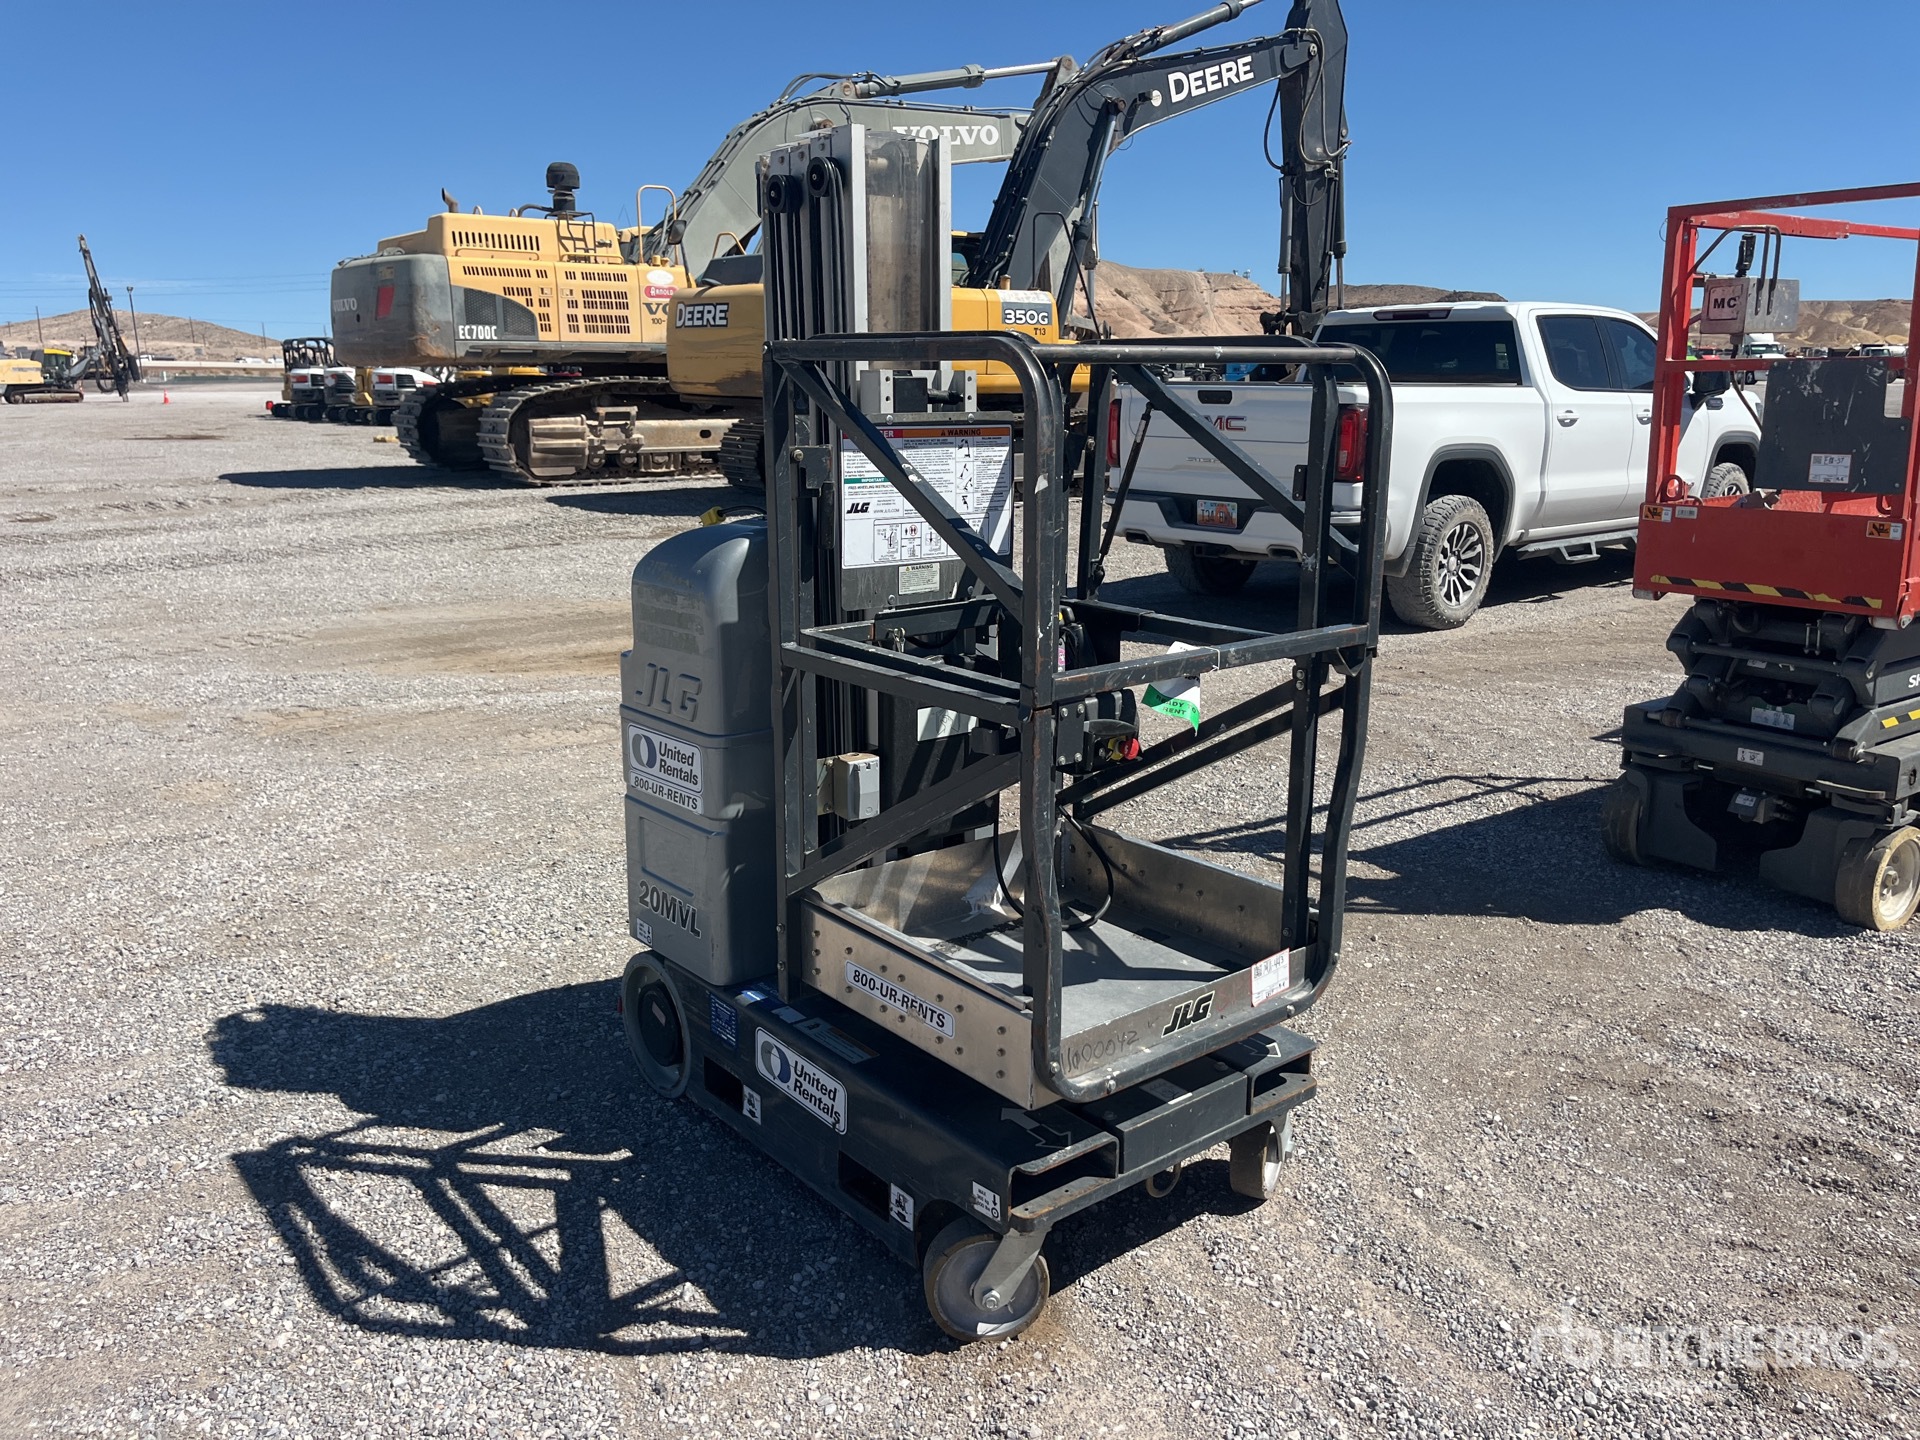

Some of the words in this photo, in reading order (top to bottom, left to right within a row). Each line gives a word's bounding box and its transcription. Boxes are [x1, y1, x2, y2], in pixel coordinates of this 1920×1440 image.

[1168, 55, 1254, 103] DEERE
[332, 298, 357, 312] VOLVO
[676, 302, 728, 327] DEERE
[1004, 309, 1048, 325] 350G
[1713, 297, 1737, 309] MC
[458, 325, 497, 339] EC700C
[846, 502, 870, 514] JLG
[634, 662, 702, 722] JLG
[658, 740, 695, 768] United
[658, 757, 699, 786] Rentals
[633, 775, 698, 811] 800-UR-RENTS
[638, 880, 702, 939] 20MVL
[852, 969, 946, 1029] 800-UR-RENTS
[1161, 991, 1215, 1038] JLG
[793, 1059, 839, 1104] United
[792, 1081, 842, 1124] Rentals
